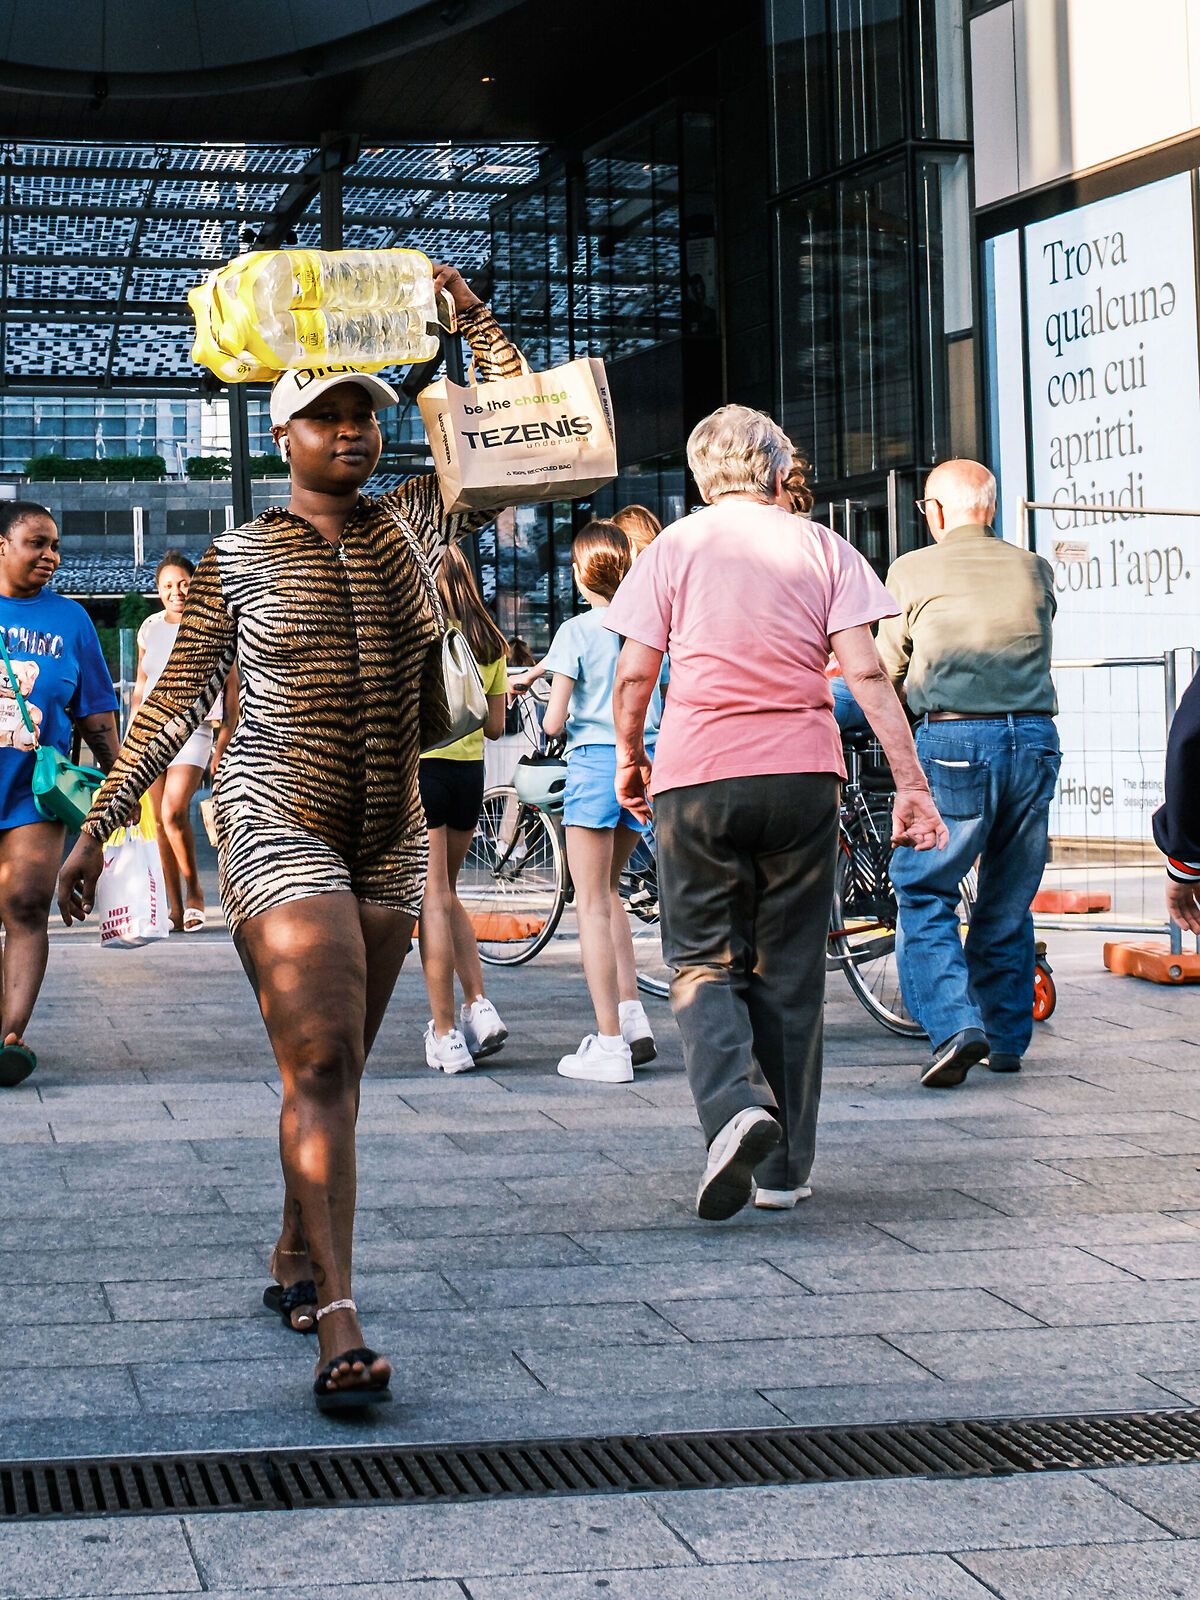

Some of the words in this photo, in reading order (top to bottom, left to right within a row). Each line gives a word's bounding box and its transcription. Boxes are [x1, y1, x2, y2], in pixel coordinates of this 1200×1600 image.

[1044, 231, 1128, 285] Trova
[1048, 367, 1096, 408] con
[1104, 342, 1148, 395] cui
[464, 404, 484, 415] be
[487, 399, 511, 412] the
[1050, 410, 1144, 480] aprirti.
[527, 466, 558, 474] RECYCLED
[558, 463, 572, 471] BAG
[1052, 472, 1146, 532] Chiudi
[1054, 554, 1102, 594] con
[1059, 777, 1114, 815] Hinge
[1122, 778, 1137, 790] The
[108, 905, 130, 919] HOT
